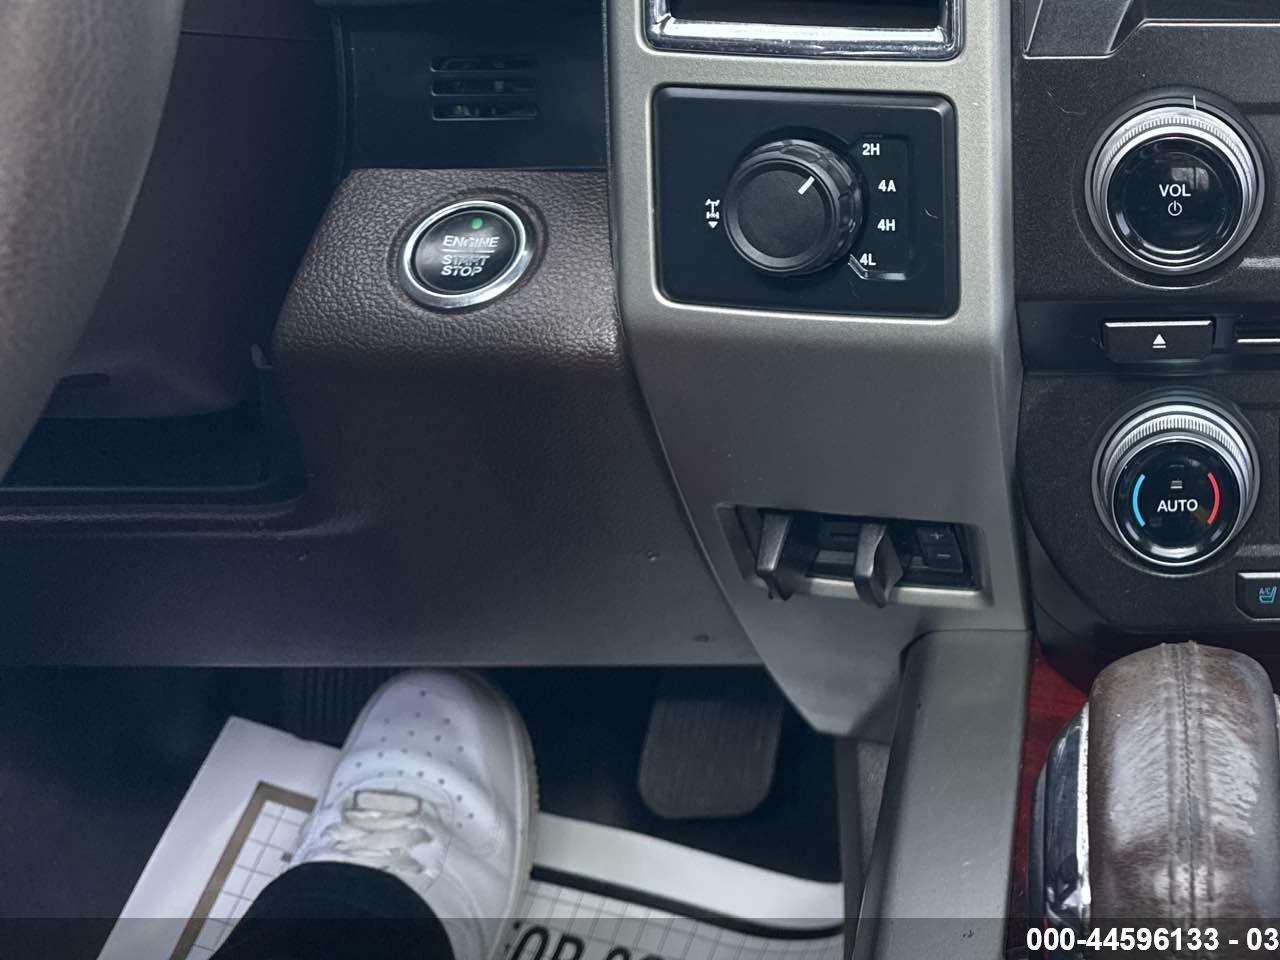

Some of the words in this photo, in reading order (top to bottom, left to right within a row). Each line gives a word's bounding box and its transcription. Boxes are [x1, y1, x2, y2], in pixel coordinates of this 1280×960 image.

[862, 143, 880, 156] 2H
[878, 180, 896, 193] 4A
[1159, 184, 1191, 197] VOL
[877, 218, 896, 232] 4H
[442, 234, 500, 248] ENGINE
[441, 255, 489, 266] START
[859, 253, 876, 266] 4L
[441, 266, 482, 277] STOP
[1157, 498, 1198, 512] AUTO
